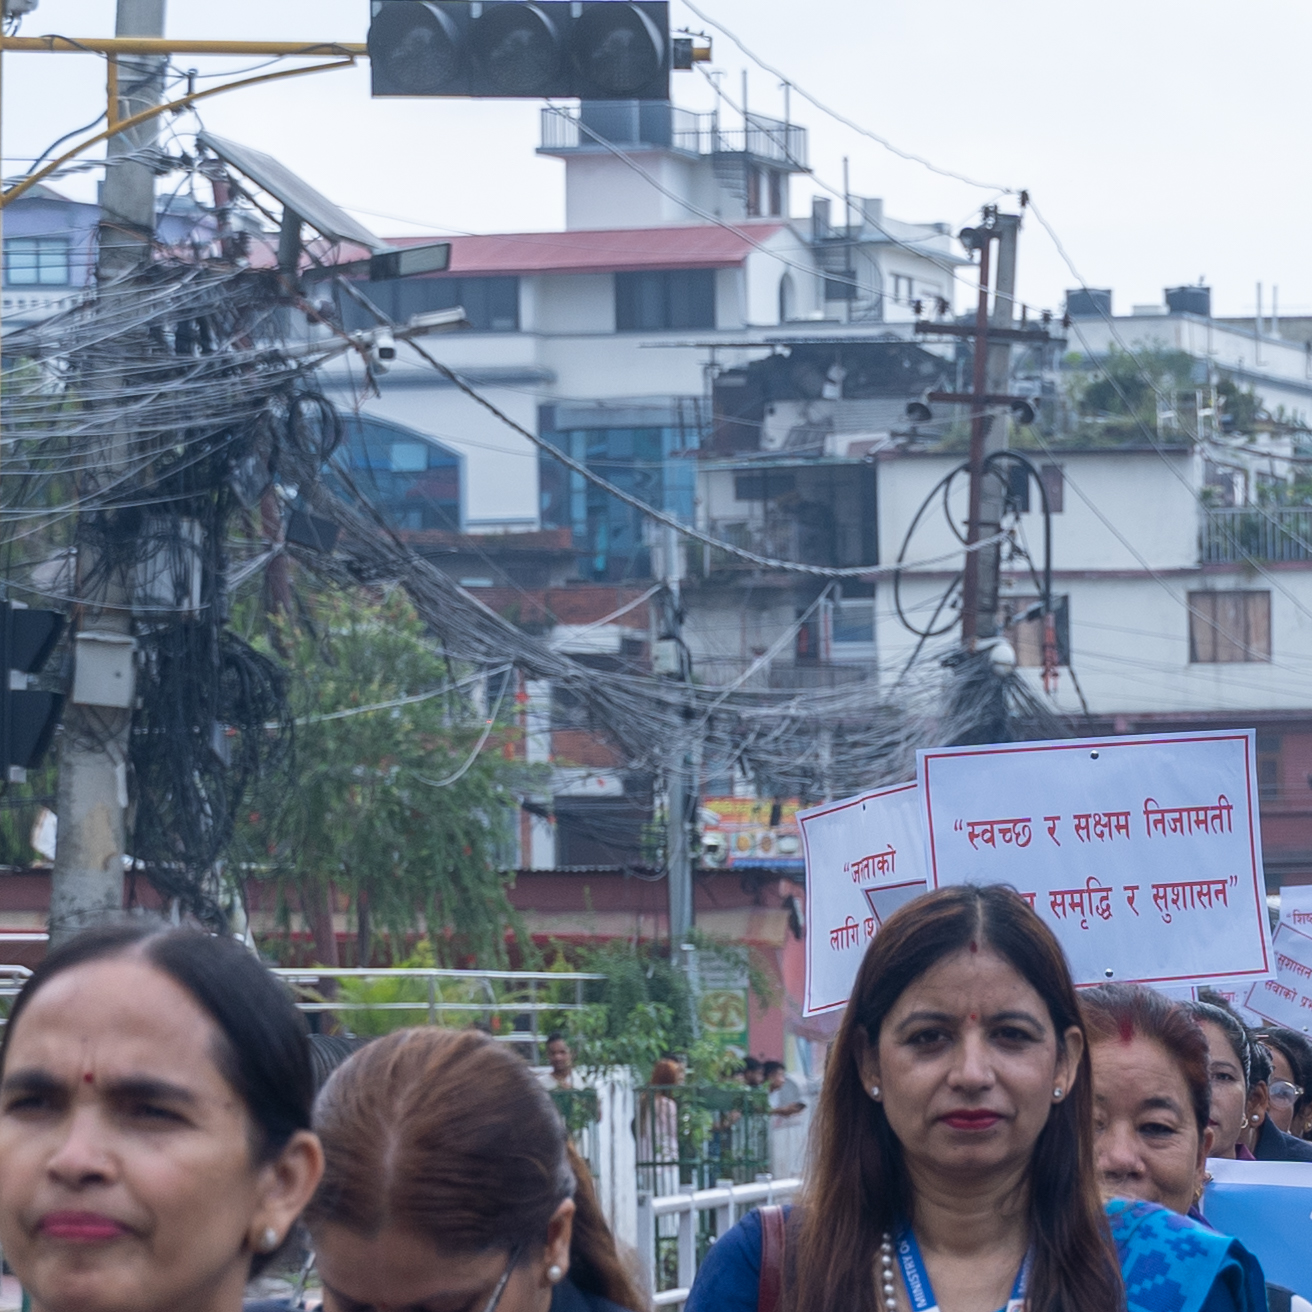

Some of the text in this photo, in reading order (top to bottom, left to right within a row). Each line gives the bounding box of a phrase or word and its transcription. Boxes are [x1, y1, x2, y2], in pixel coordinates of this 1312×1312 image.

[953, 794, 1234, 851] “स्वच्छ र सक्षम निजामती
[1049, 876, 1112, 930] समृद्धि
[1123, 884, 1139, 916] र
[1152, 875, 1238, 924] सुशासन”
[830, 916, 859, 950] लागि
[901, 1255, 928, 1309] MINISTRY
